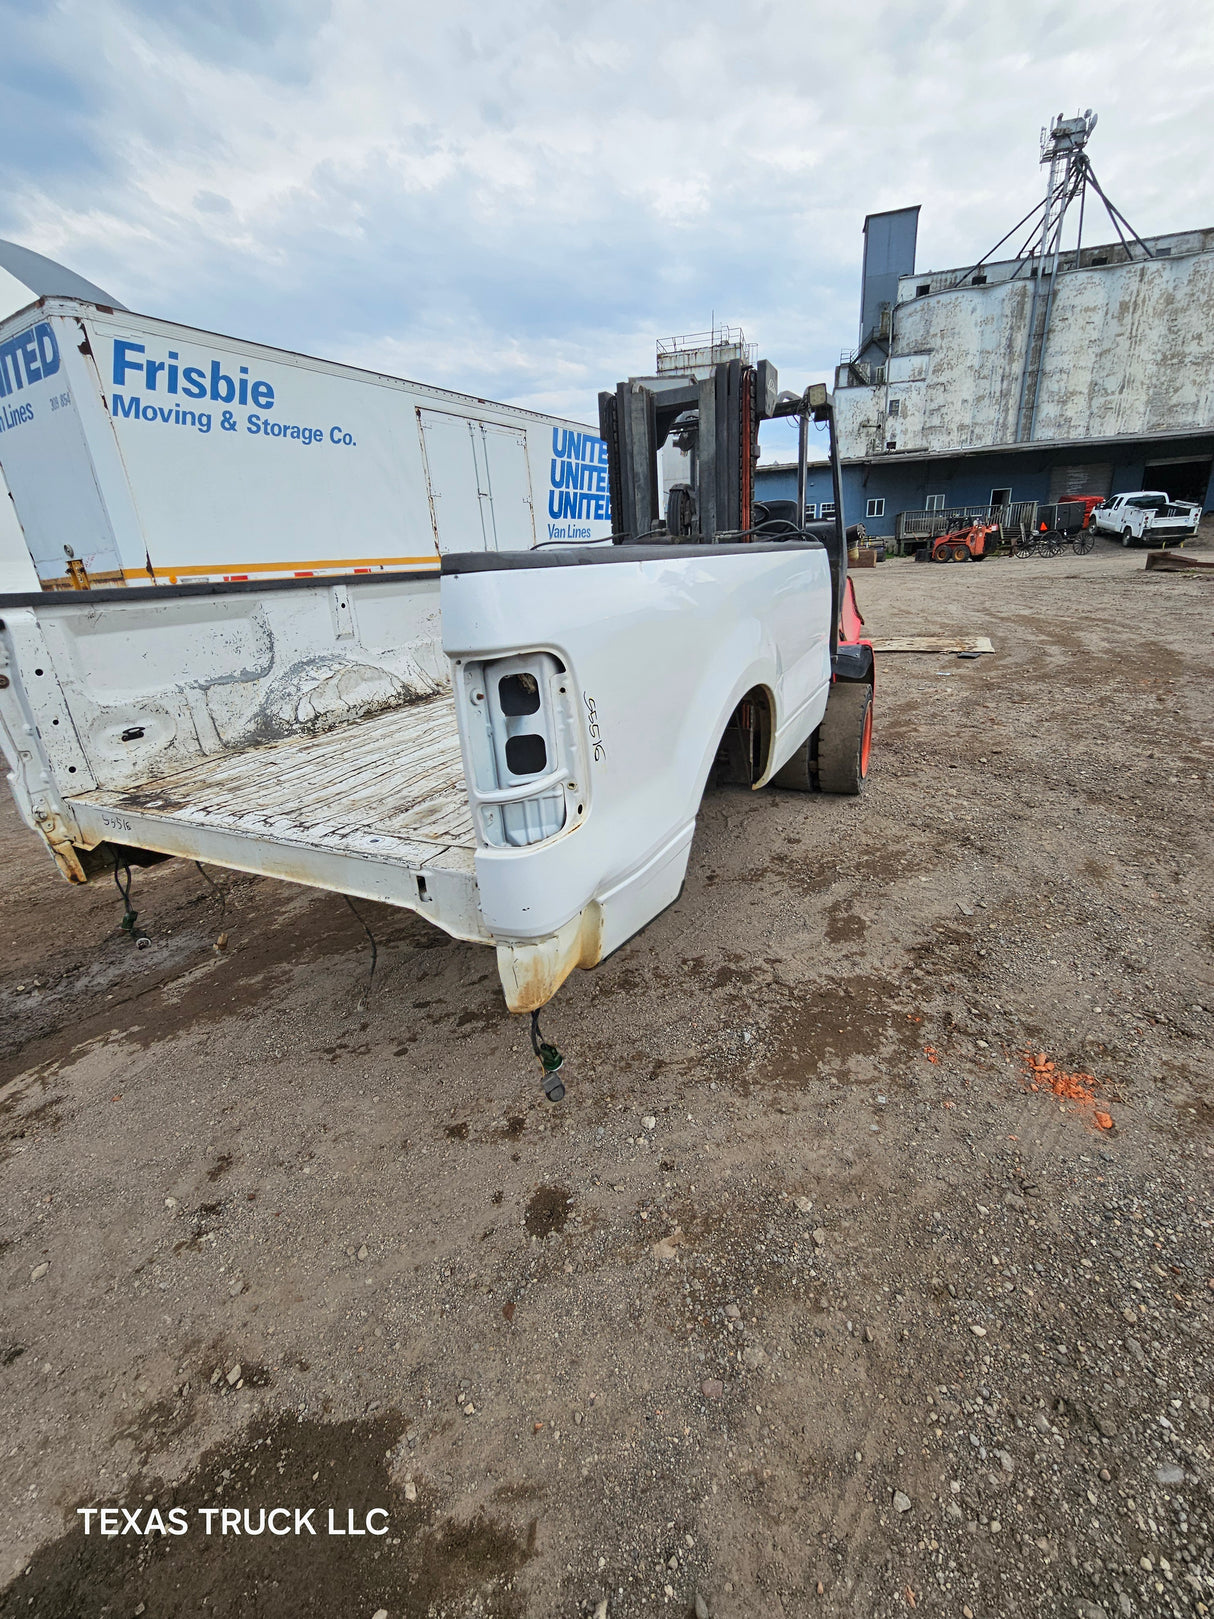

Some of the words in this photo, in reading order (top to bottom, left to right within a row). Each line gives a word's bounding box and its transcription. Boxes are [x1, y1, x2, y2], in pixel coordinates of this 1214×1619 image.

[112, 338, 275, 410] Frisbie
[2, 403, 34, 429] Lines
[112, 393, 212, 433] Moving
[220, 410, 237, 432] &
[246, 413, 324, 446] Storage
[329, 425, 357, 447] Co.
[552, 427, 608, 466] UNITE
[550, 458, 610, 494] UNITE
[547, 523, 566, 539] Van
[567, 524, 591, 539] Lines
